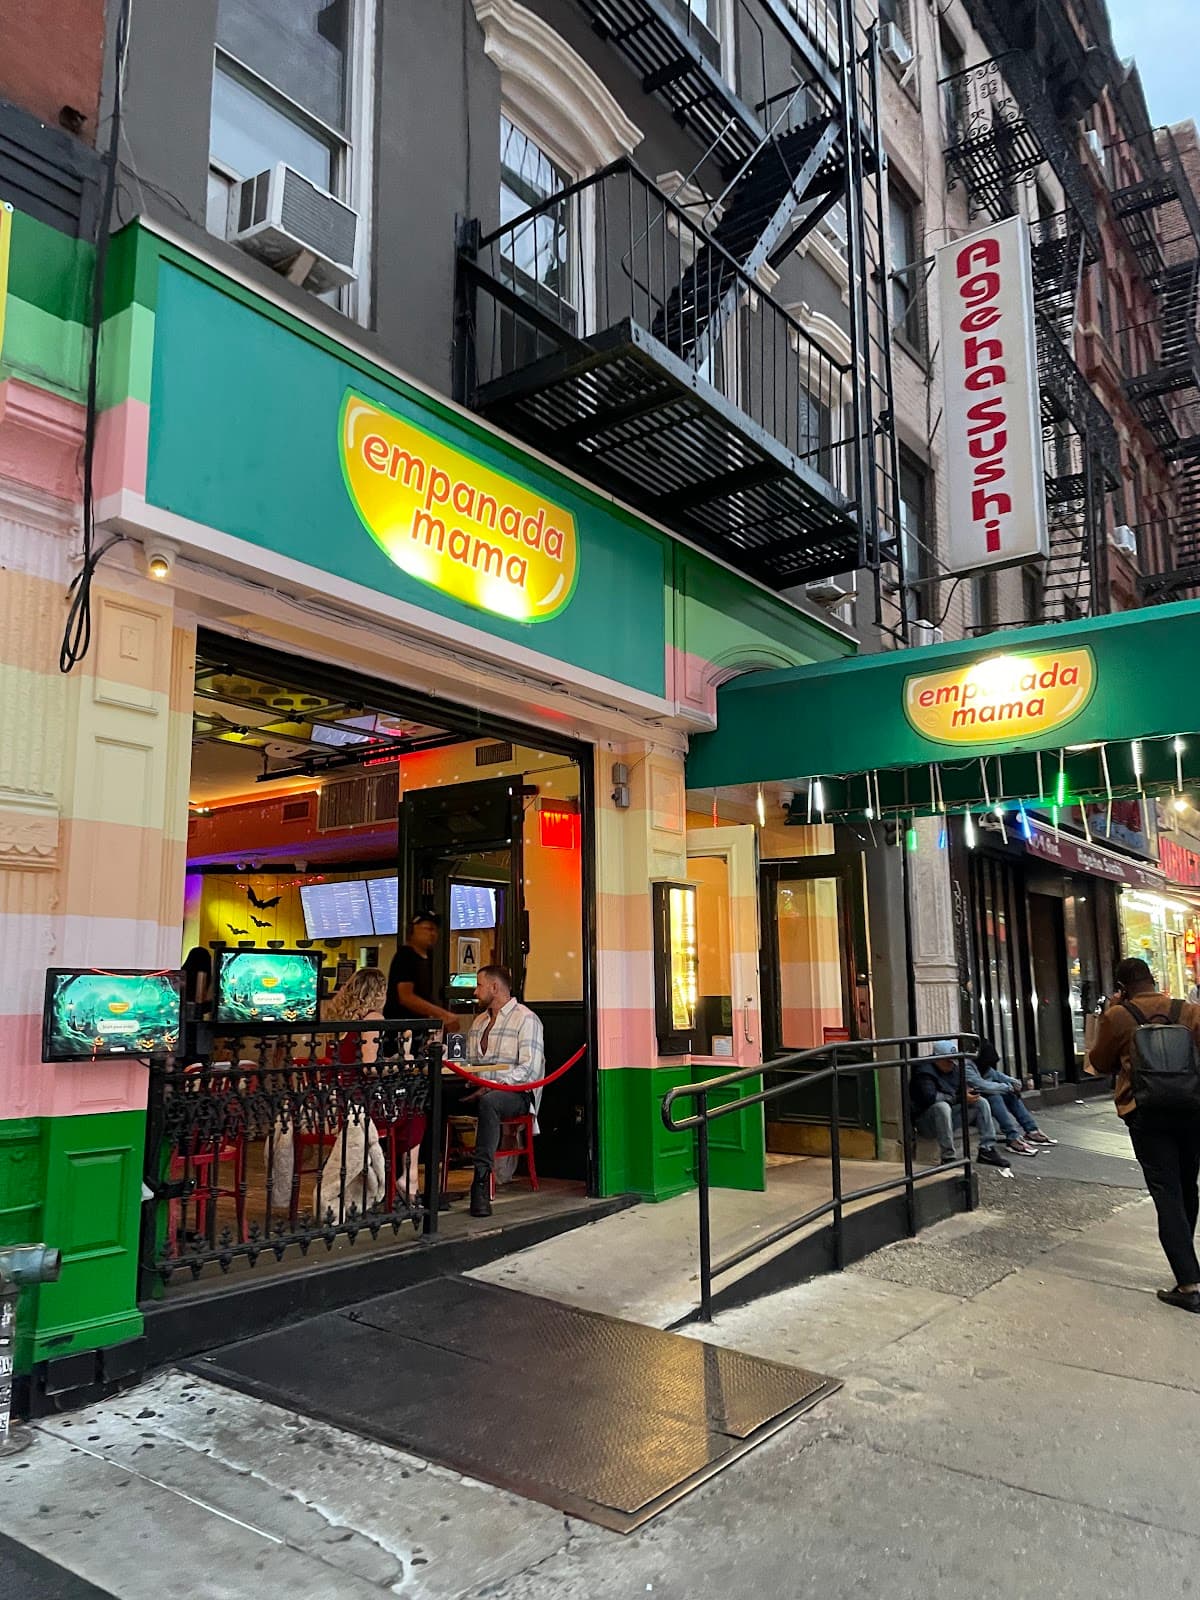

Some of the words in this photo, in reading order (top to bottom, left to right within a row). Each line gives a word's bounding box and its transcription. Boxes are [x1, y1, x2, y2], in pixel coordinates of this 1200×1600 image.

[362, 435, 565, 560] empanada
[411, 509, 528, 588] mama
[918, 662, 1079, 708] empada
[951, 698, 1046, 728] mama
[463, 944, 475, 964] A
